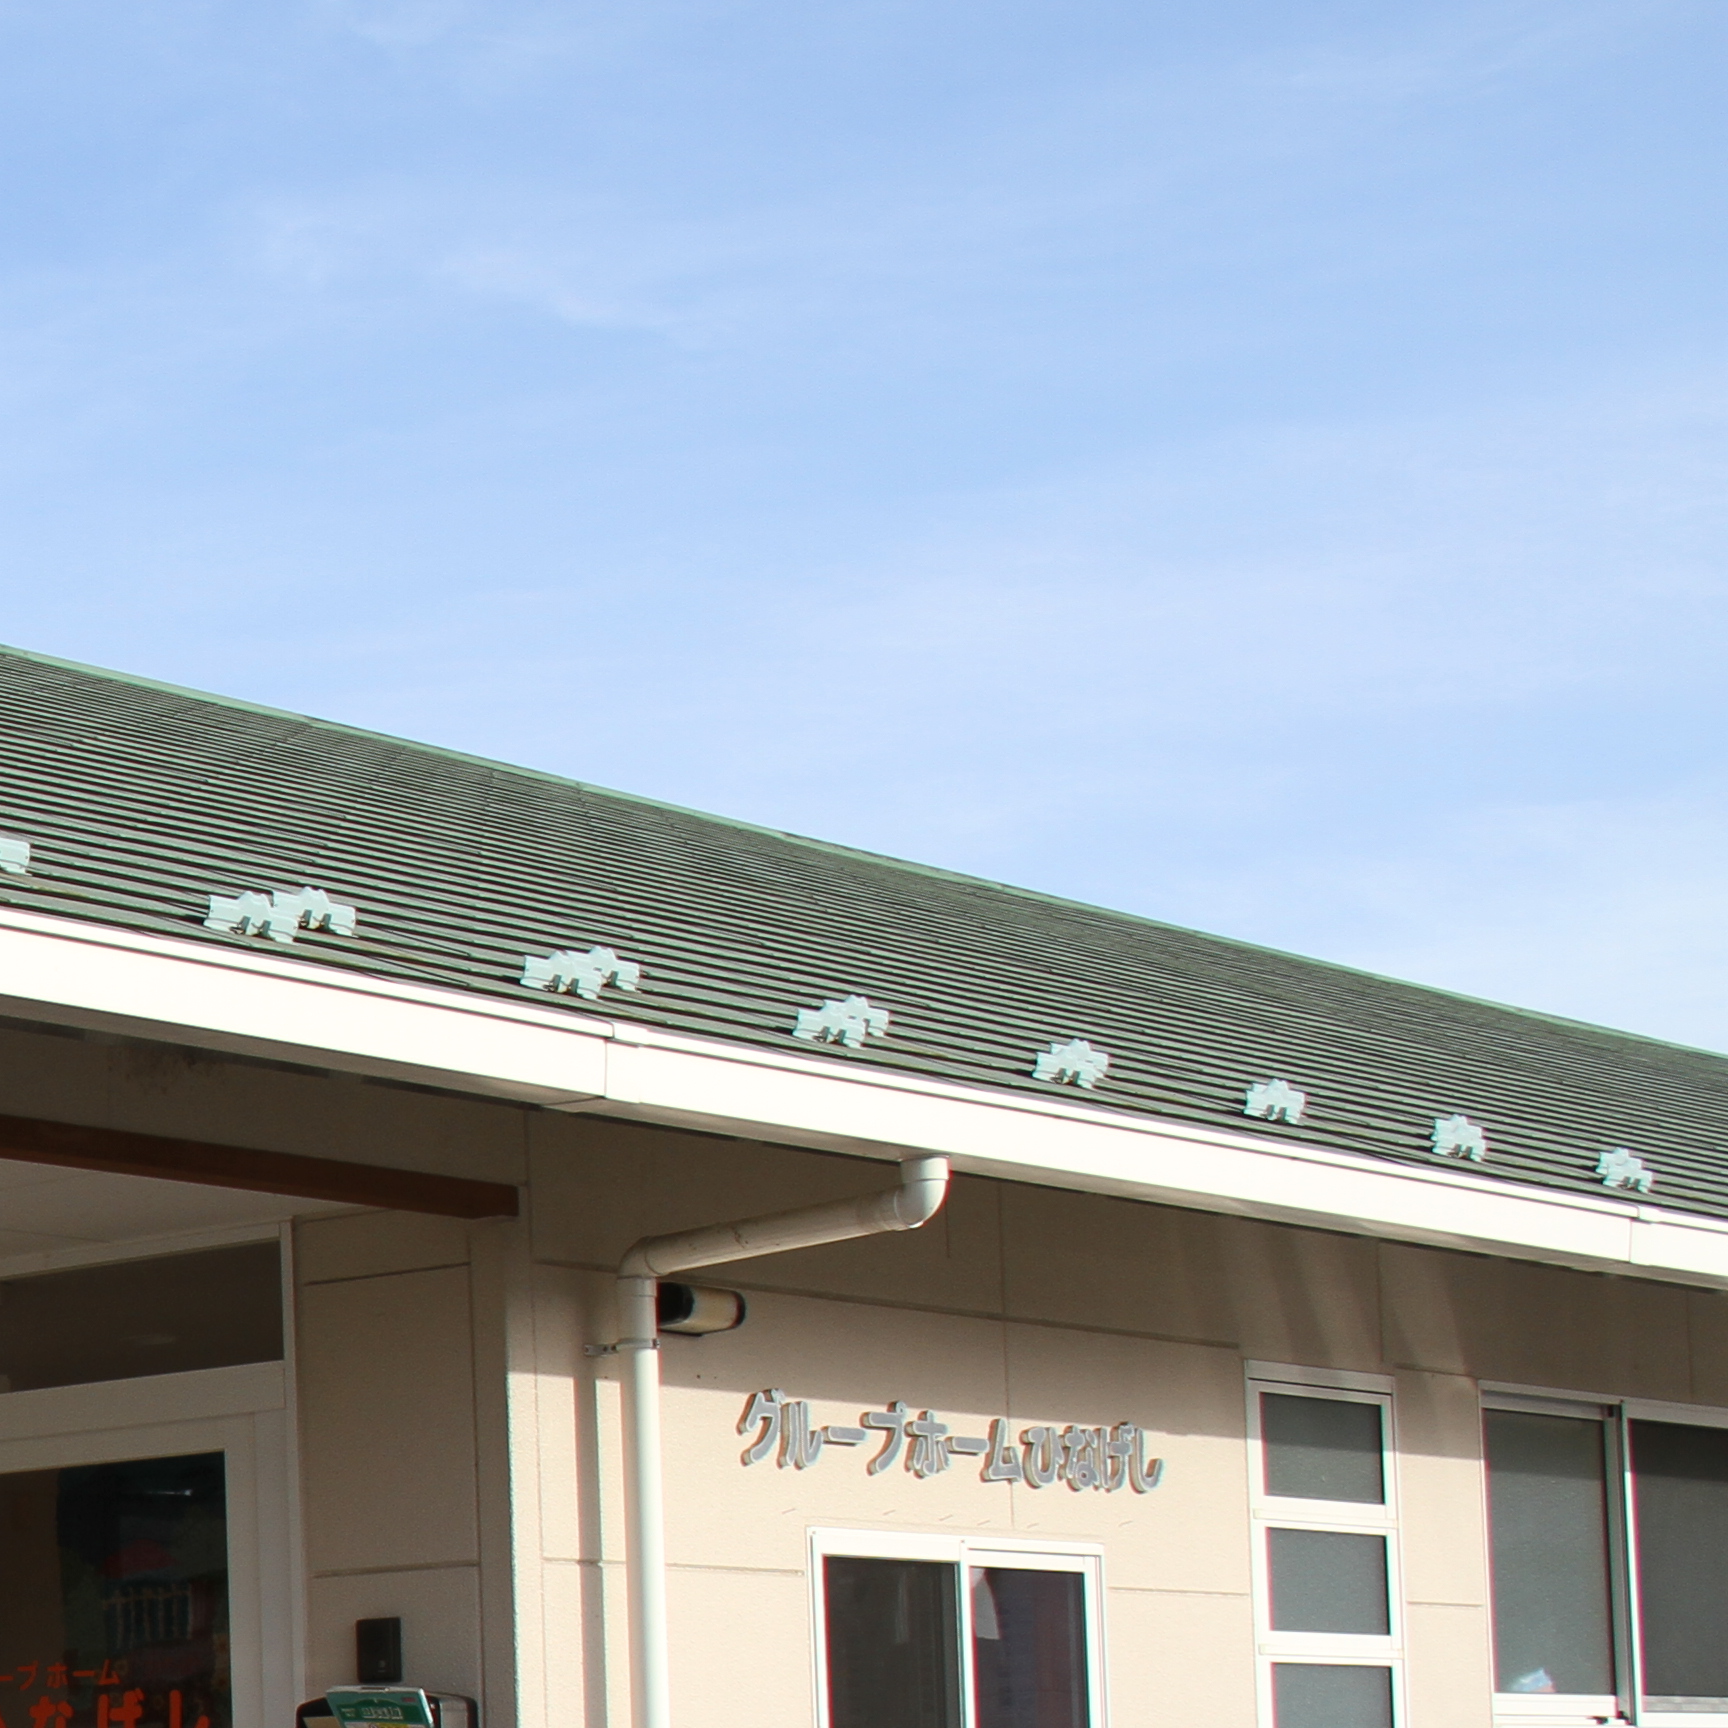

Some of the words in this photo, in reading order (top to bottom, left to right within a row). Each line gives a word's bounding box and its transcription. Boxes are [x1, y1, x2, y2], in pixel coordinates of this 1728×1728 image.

[737, 1387, 1165, 1494] グループホームひなげし
